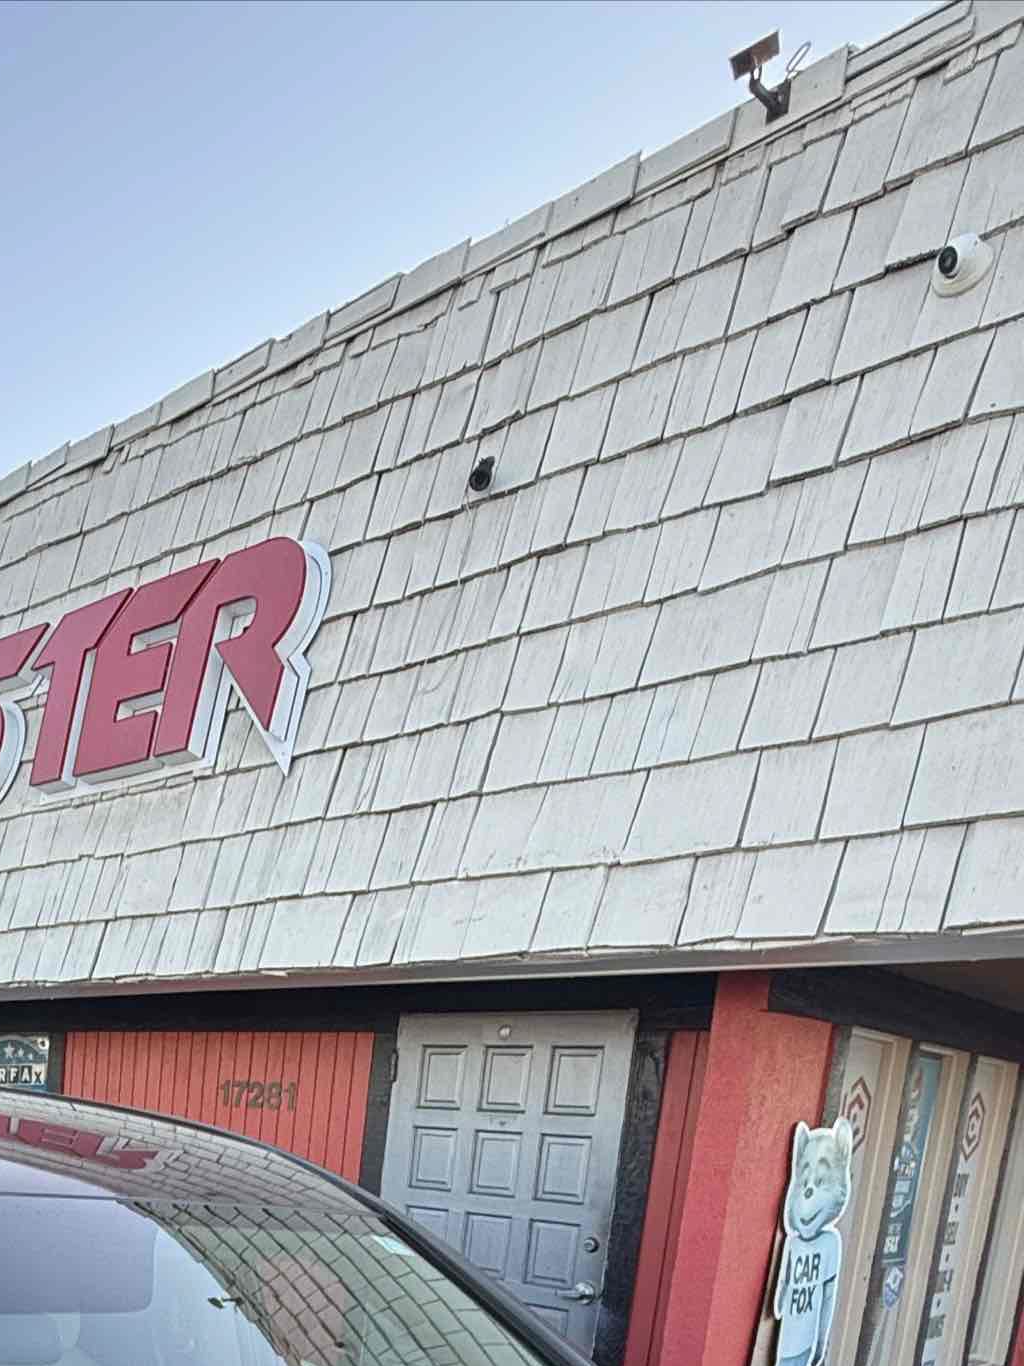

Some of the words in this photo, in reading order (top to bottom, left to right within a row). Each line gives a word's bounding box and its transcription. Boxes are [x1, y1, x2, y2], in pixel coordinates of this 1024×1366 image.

[220, 1080, 296, 1111] 17281
[794, 1253, 821, 1284] CAR
[790, 1284, 816, 1315] FOX
